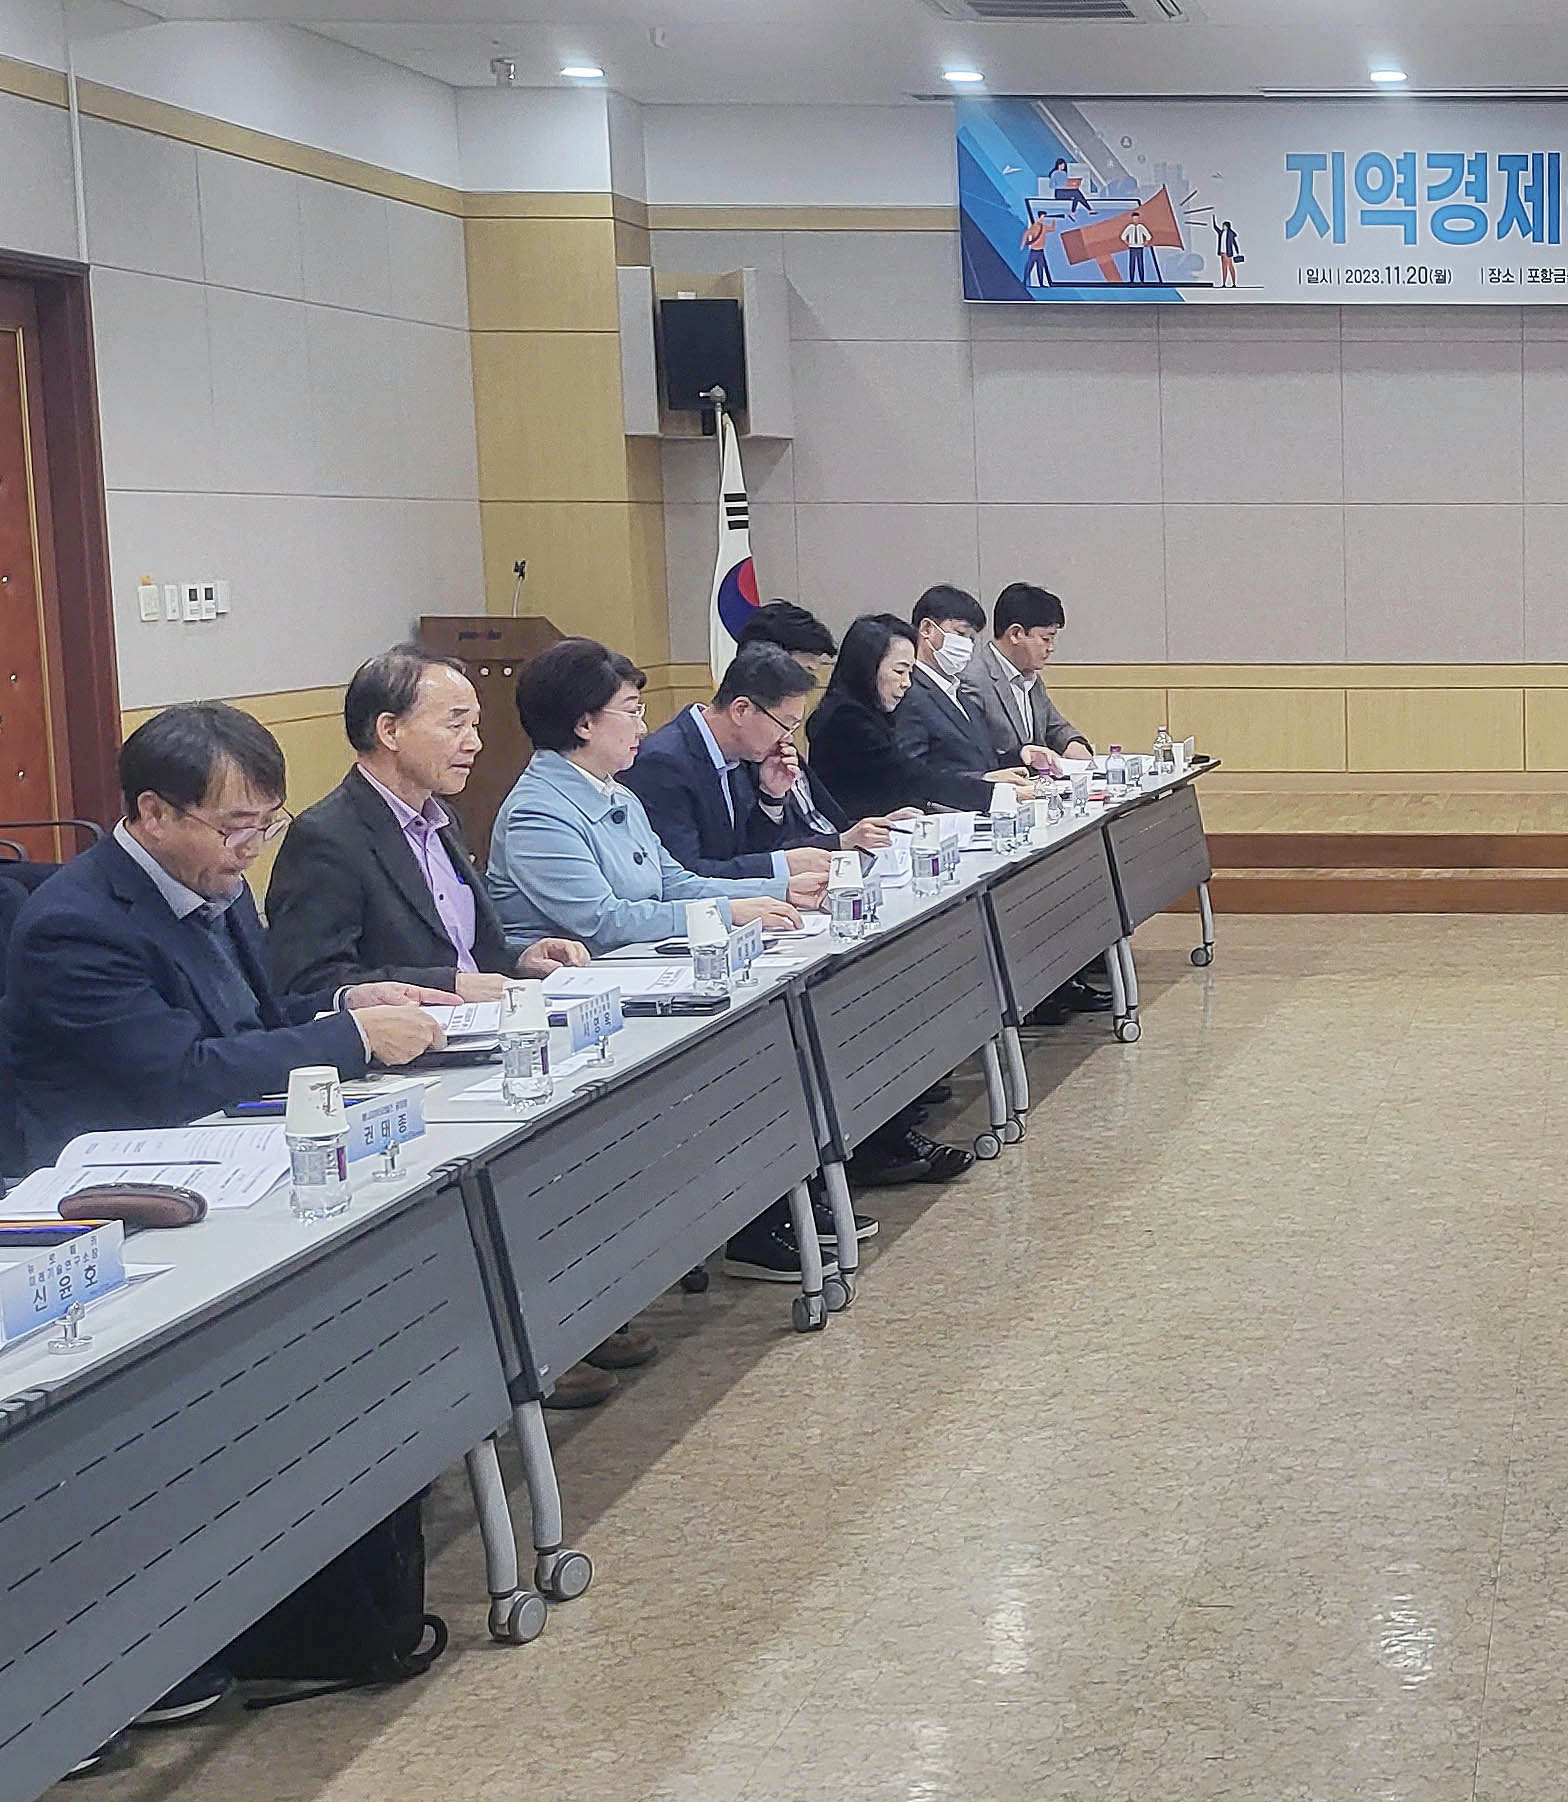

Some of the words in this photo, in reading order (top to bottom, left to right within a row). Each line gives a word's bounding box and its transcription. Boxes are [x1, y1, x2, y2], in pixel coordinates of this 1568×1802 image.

[1305, 267, 1333, 285] 일시
[1344, 265, 1453, 286] 2023.11.20(월)
[1488, 267, 1515, 284] 장소
[33, 1263, 99, 1313] 신윤호
